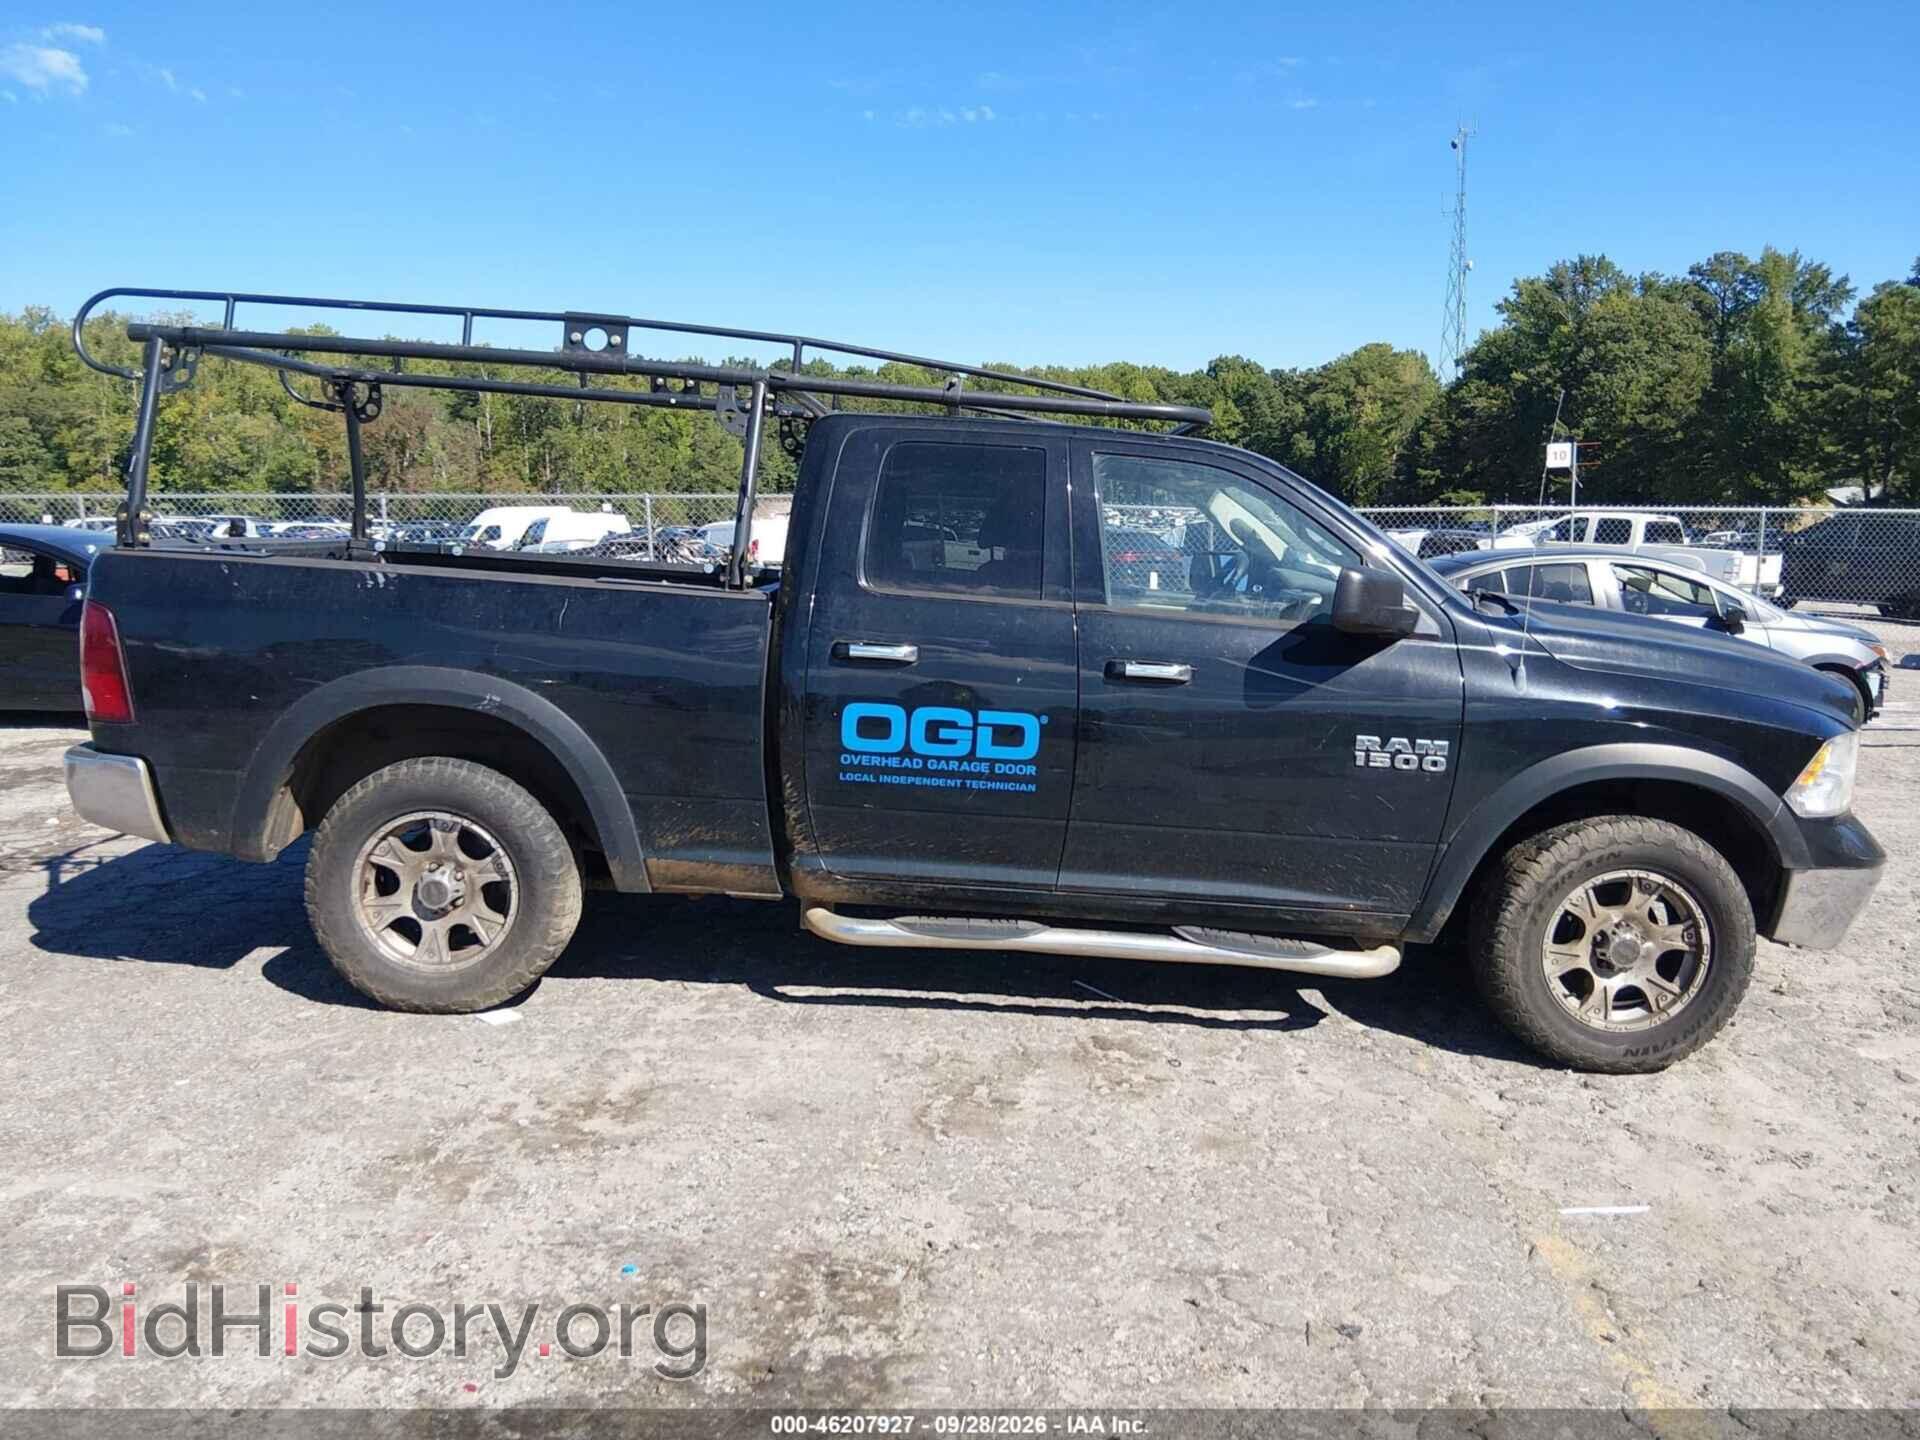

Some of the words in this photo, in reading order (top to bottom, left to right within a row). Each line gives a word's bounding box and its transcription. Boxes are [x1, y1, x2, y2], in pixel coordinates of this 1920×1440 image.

[1552, 451, 1567, 461] 10
[1355, 735, 1450, 755] RAM
[840, 754, 923, 769] OVERHEAD
[927, 759, 990, 773] GARAGE
[995, 763, 1036, 775] DOOR
[1354, 751, 1447, 772] 1500
[840, 772, 877, 783] LOCAL
[879, 775, 962, 788] INDEPENDENT
[965, 780, 1036, 793] TECHNICIAN
